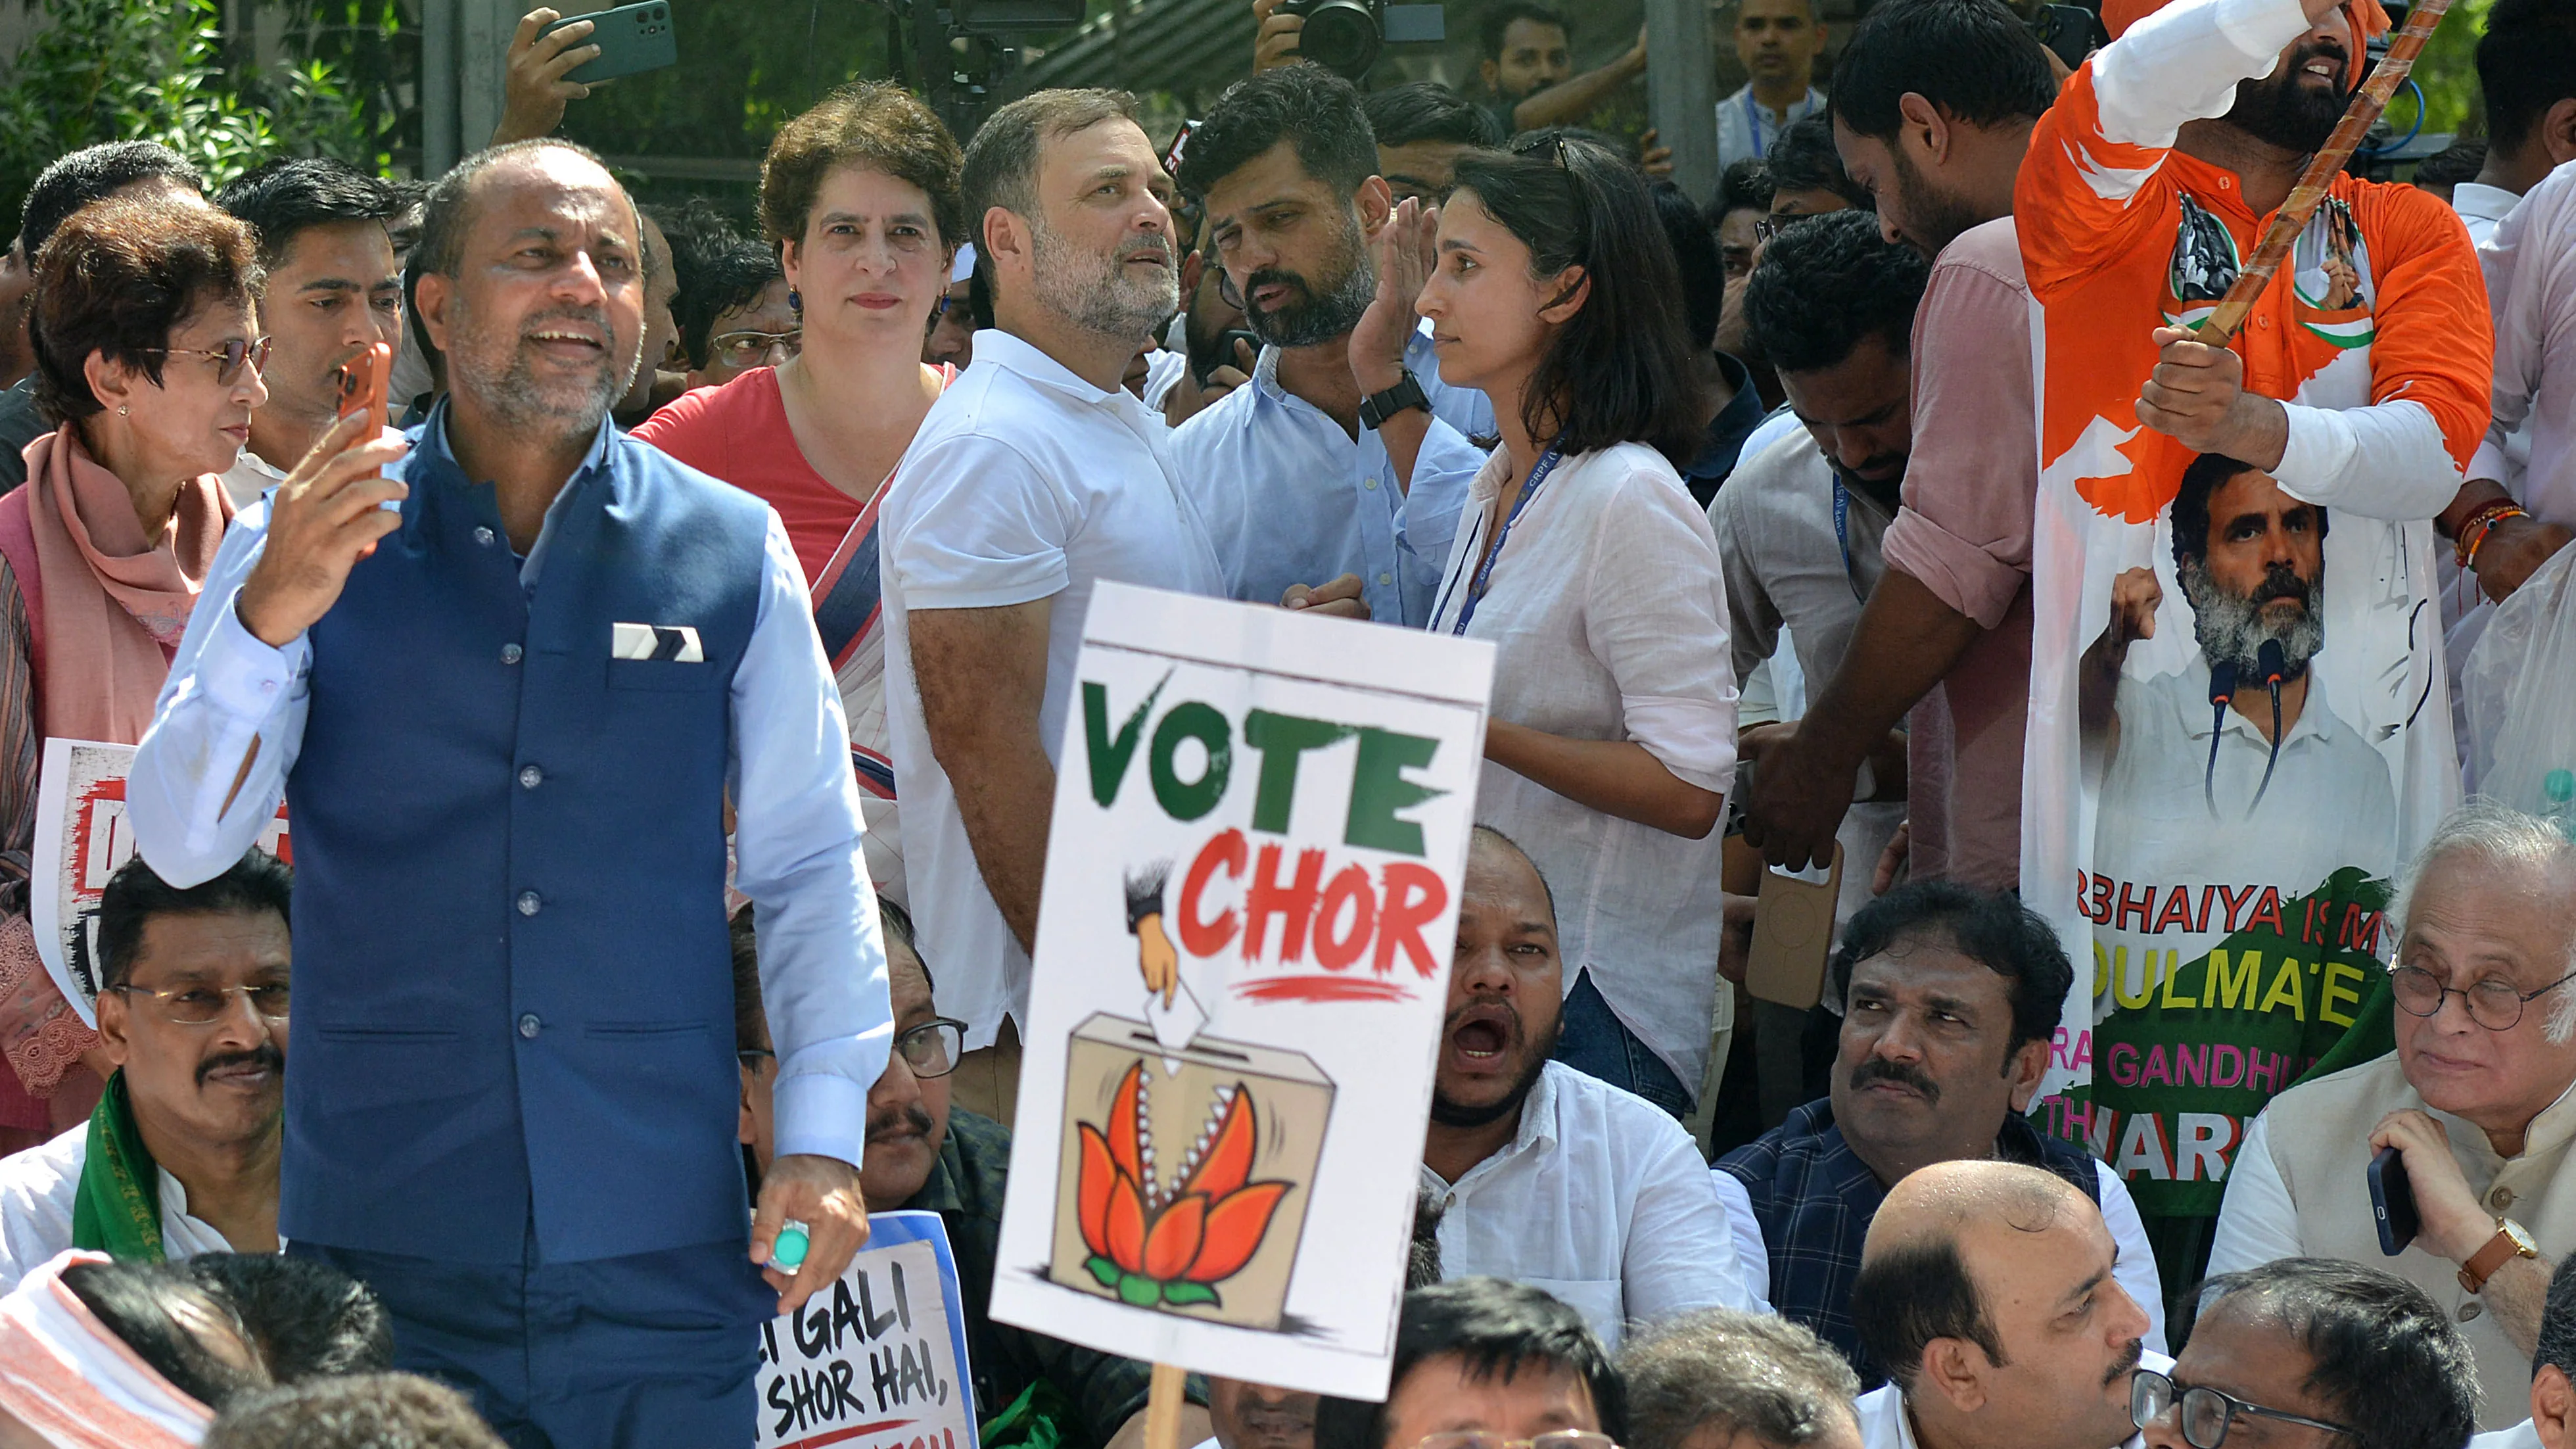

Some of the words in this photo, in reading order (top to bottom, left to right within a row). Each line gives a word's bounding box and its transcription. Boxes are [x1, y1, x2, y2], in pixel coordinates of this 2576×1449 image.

[1529, 460, 1549, 487] CRPF
[1081, 663, 1452, 857] VOTE
[1178, 826, 1448, 980] CHOR
[792, 1261, 912, 1359] GALI
[767, 1359, 866, 1438] SHOR
[869, 1338, 948, 1413] HAI,
